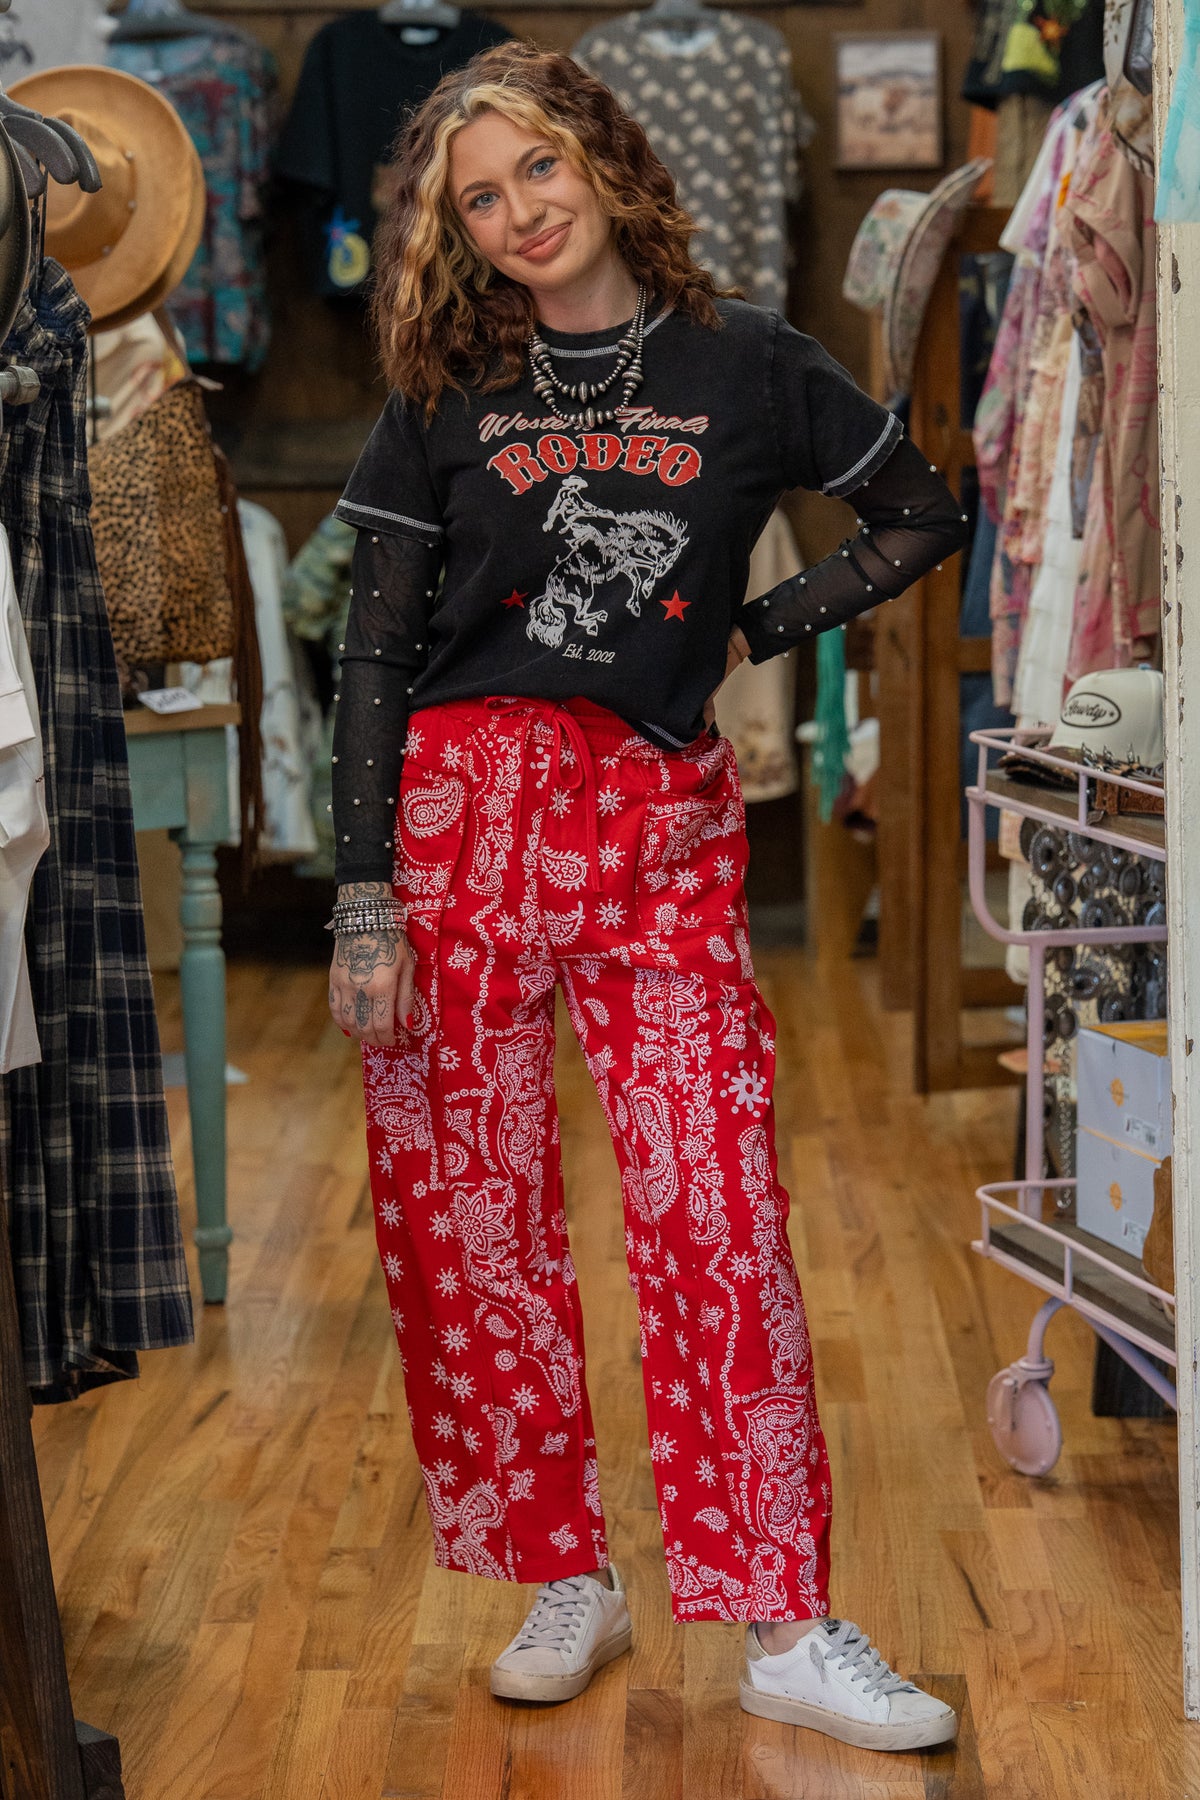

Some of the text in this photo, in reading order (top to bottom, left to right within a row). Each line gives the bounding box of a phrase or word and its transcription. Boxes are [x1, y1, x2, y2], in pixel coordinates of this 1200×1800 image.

[614, 405, 710, 435] Finals
[486, 433, 702, 495] RODEO
[561, 643, 616, 664] Est. 2002
